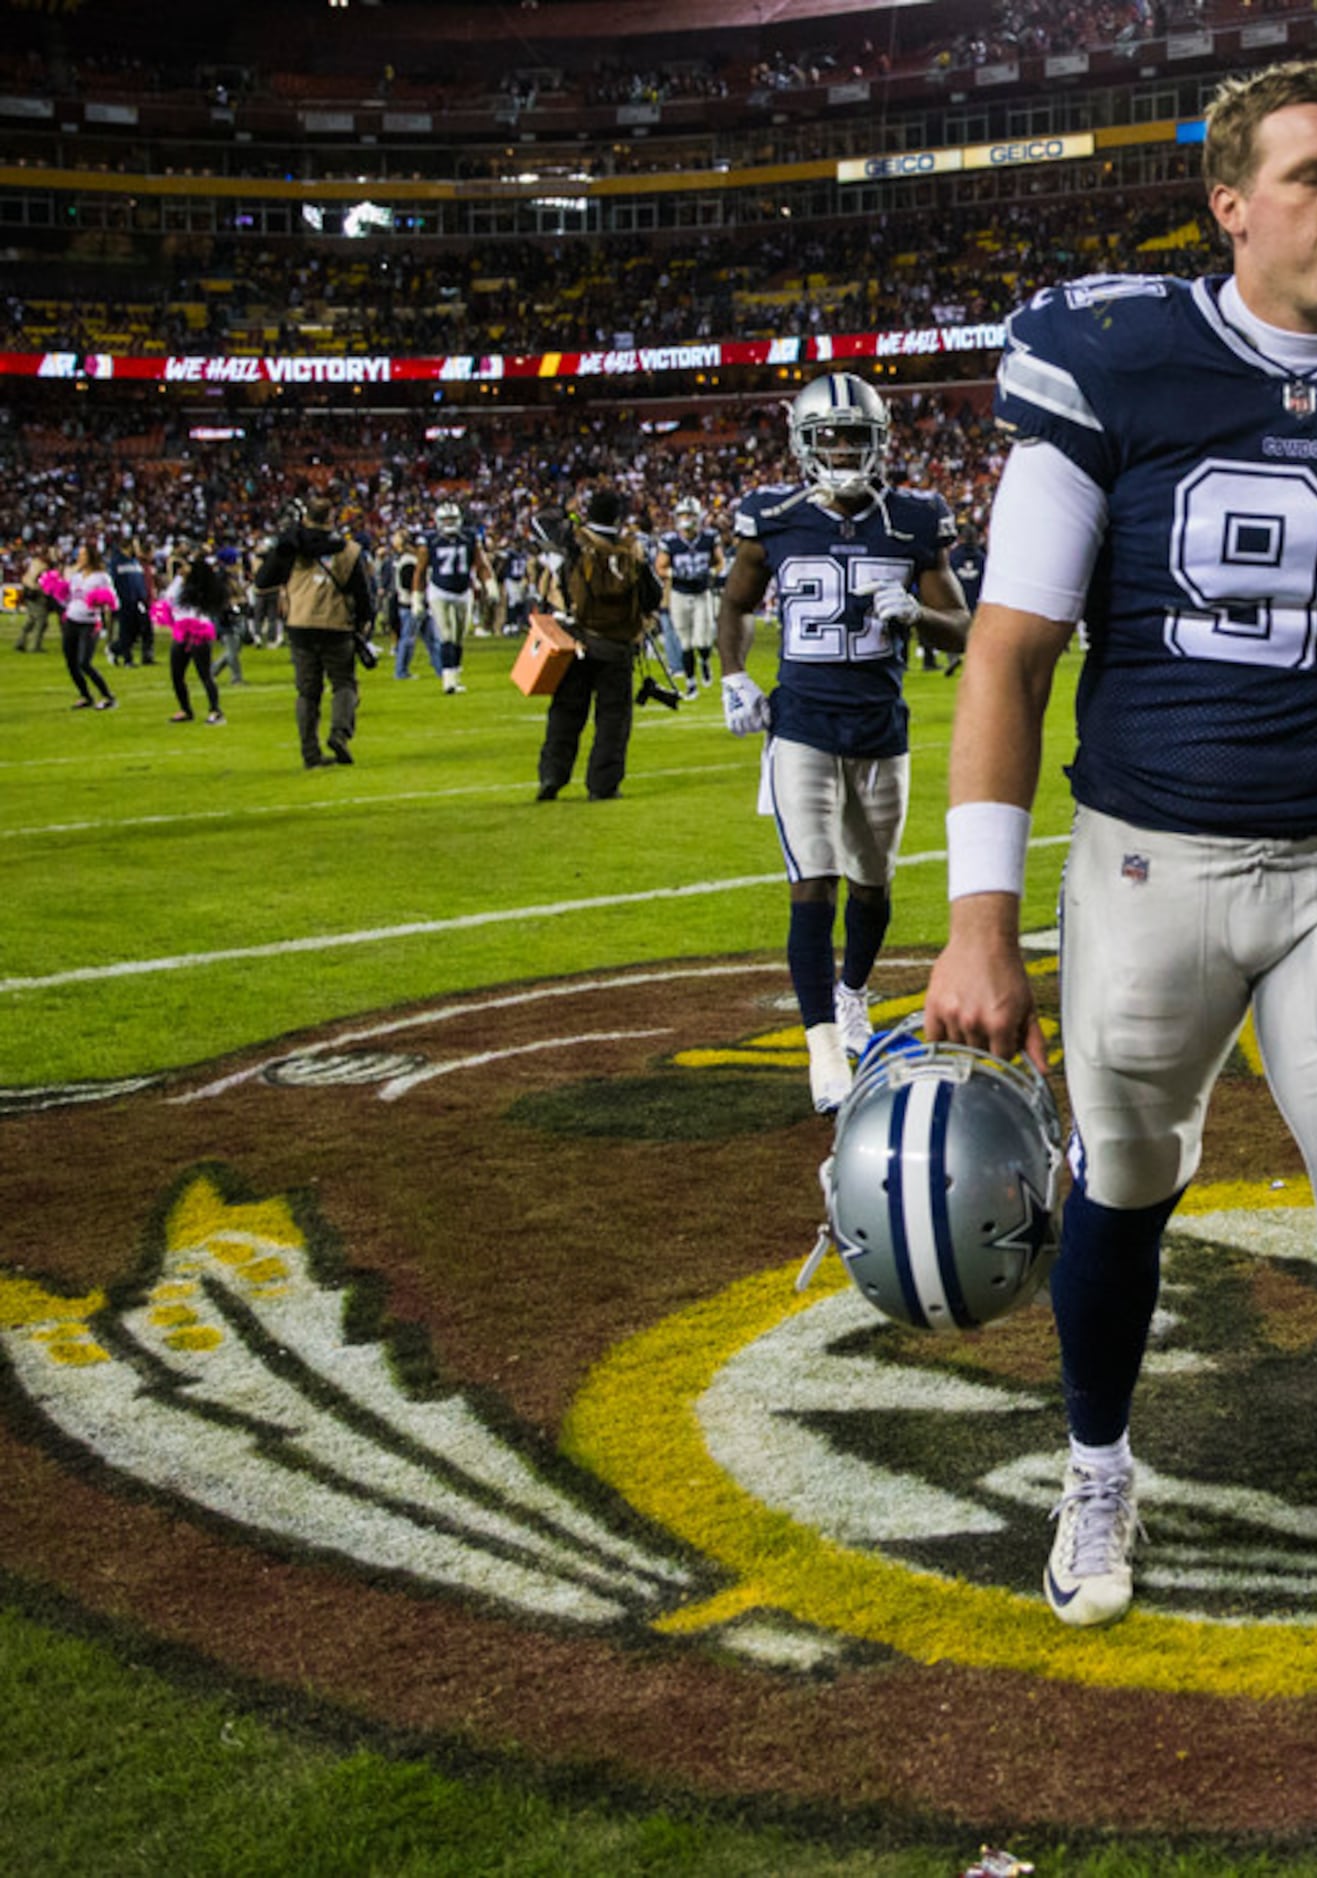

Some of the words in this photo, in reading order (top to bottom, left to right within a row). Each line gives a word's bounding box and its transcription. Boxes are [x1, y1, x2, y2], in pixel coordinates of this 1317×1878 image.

[865, 153, 934, 177] GEICO
[990, 140, 1063, 165] GEICO
[876, 332, 903, 356] WE
[164, 356, 202, 381] WE
[205, 355, 261, 382] HAIL
[264, 355, 390, 382] VICTORY!
[577, 353, 602, 375] WE
[639, 344, 721, 369] VICTORY!
[436, 545, 468, 575] 71
[778, 555, 915, 662] 27
